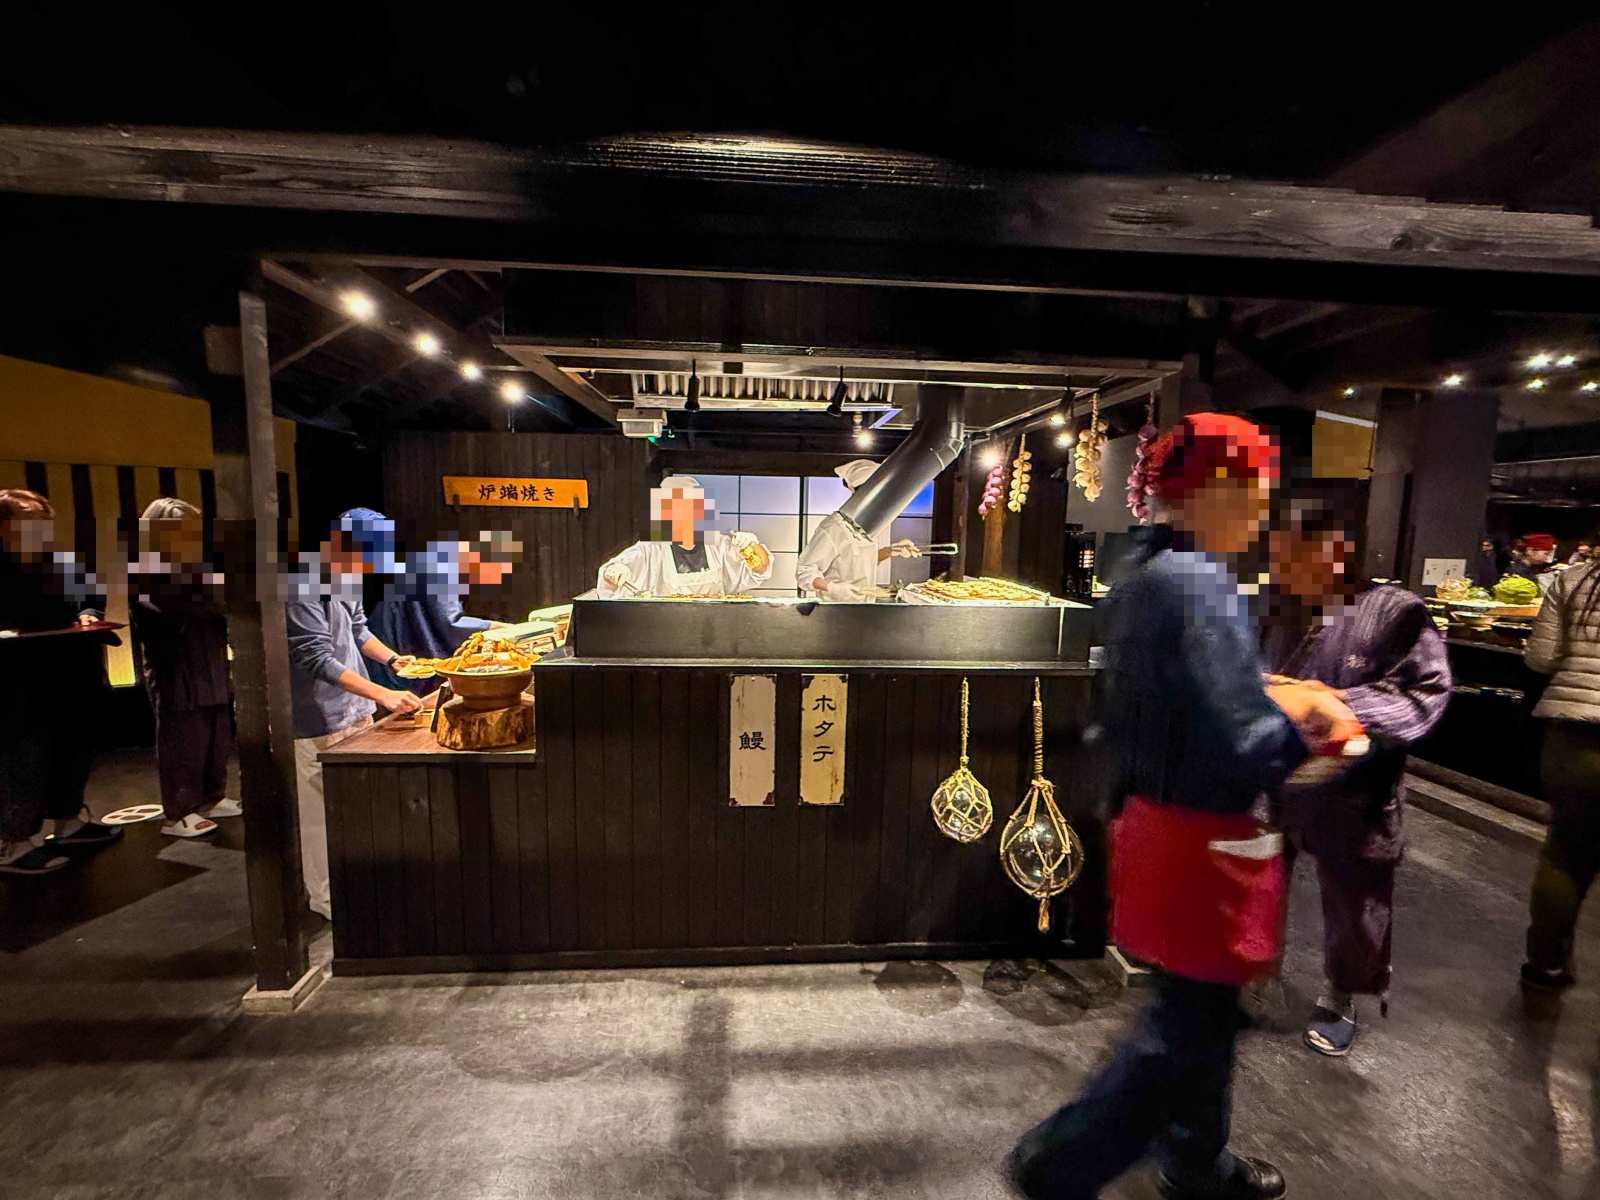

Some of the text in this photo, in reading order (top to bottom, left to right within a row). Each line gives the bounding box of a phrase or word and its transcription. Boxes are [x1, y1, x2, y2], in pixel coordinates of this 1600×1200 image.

[478, 484, 555, 502] 炉端焼き
[812, 694, 836, 763] ホタテ
[739, 731, 767, 750] 鰻
